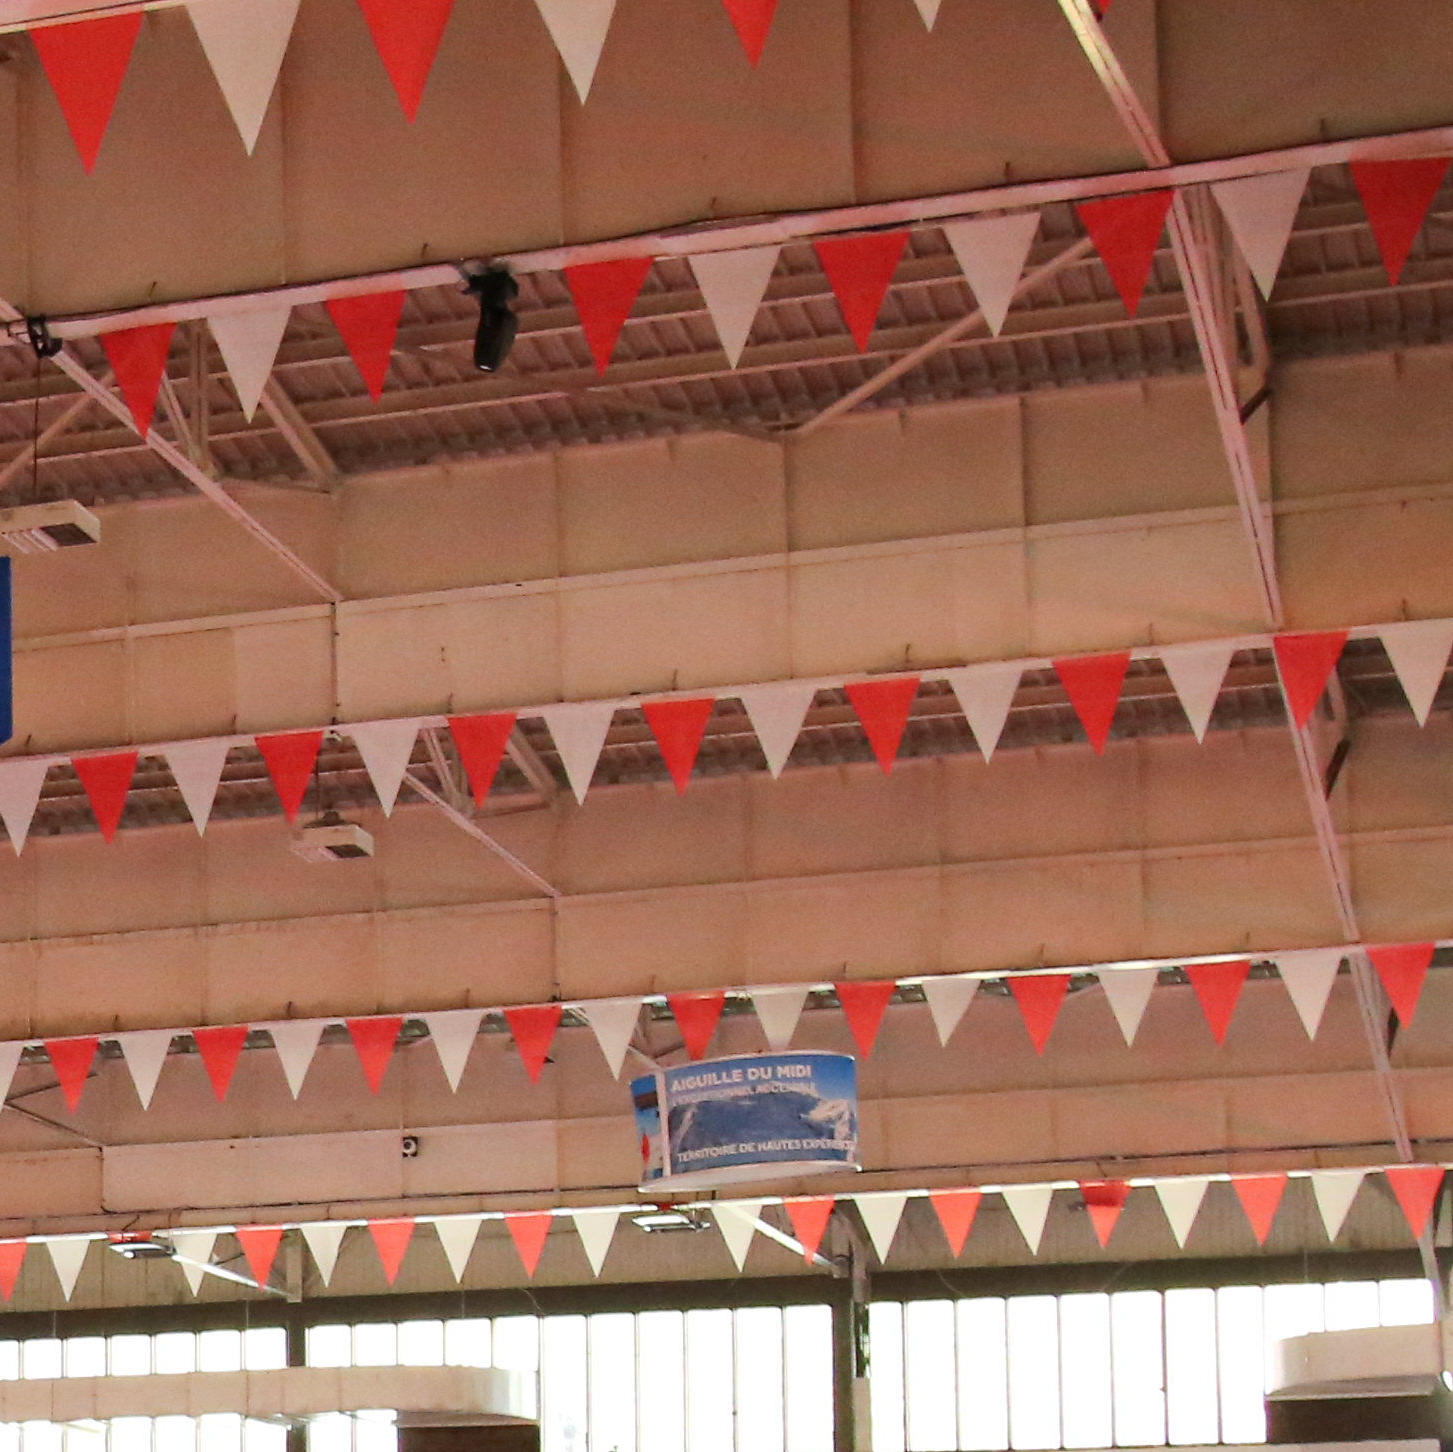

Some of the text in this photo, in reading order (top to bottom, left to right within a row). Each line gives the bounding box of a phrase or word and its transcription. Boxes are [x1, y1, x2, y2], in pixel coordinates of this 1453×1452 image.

[671, 1064, 812, 1092] AIGUILLE DU MIDI
